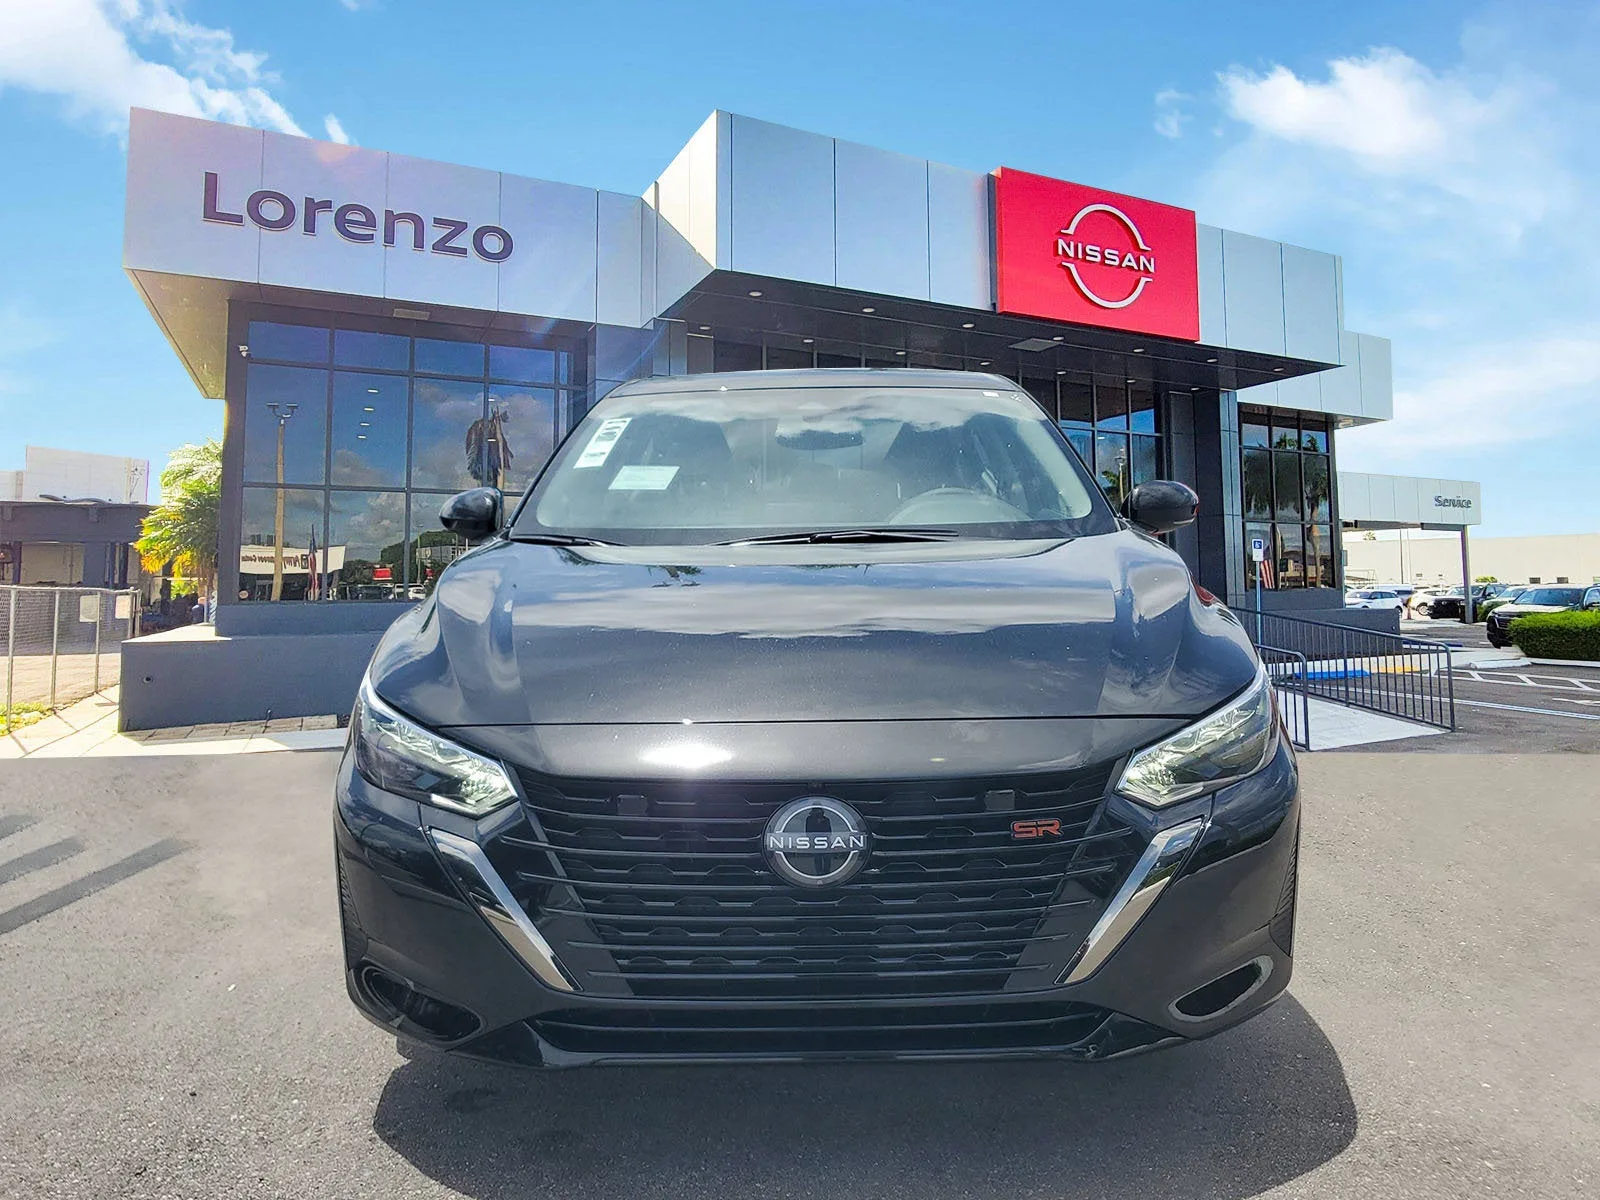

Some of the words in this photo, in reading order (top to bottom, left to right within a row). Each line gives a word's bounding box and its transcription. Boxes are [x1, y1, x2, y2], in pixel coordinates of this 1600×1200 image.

[202, 171, 514, 262] Lorenzo
[1057, 238, 1155, 273] NISSAN
[1434, 495, 1472, 509] Service
[1012, 818, 1063, 839] SR
[768, 835, 864, 849] NISSAN
